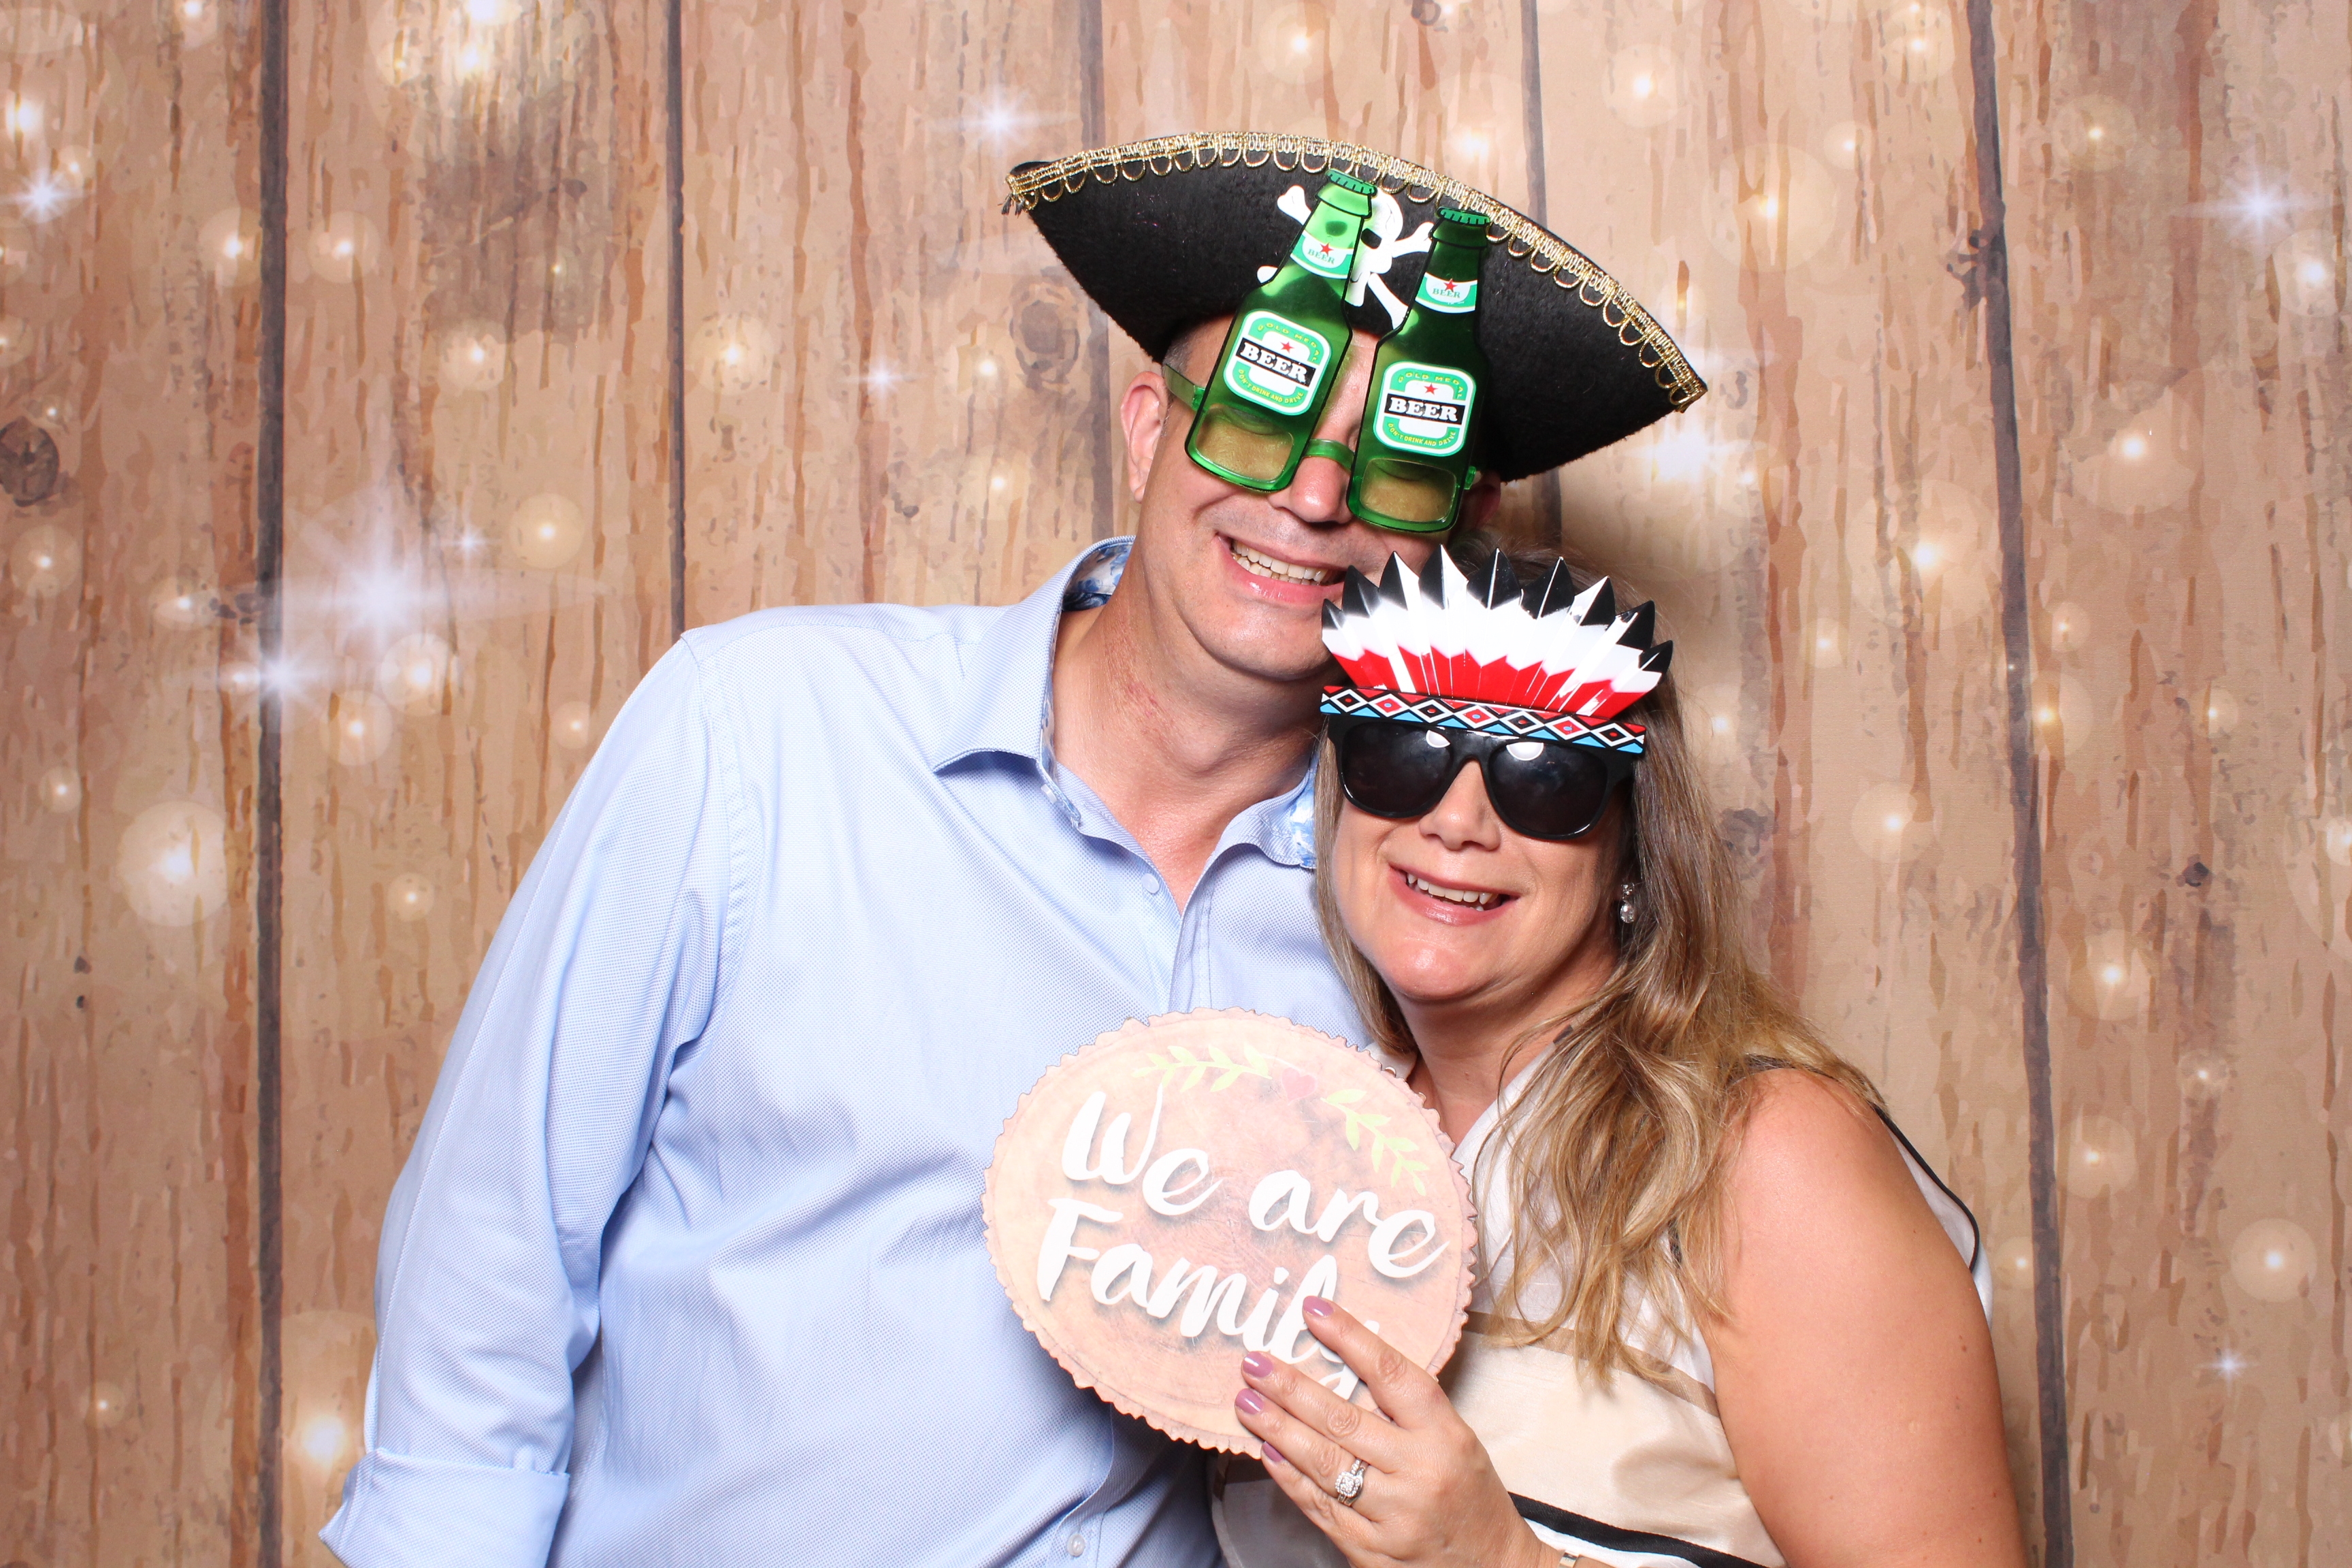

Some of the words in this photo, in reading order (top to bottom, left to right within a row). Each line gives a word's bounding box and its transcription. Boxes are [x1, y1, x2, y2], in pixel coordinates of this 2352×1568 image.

[1307, 248, 1335, 264] BEER
[1432, 288, 1460, 299] BEER
[1257, 322, 1290, 334] GOLD
[1294, 333, 1320, 362] MEDAL
[1239, 342, 1307, 383] BEER
[1238, 369, 1252, 389] DON'T
[1252, 385, 1271, 397] DRINK
[1271, 393, 1283, 404] AND
[1284, 391, 1304, 404] DRIVE
[1398, 372, 1429, 383] GOLD
[1435, 376, 1465, 399] MEDAL
[1388, 397, 1458, 422] BEER
[1388, 423, 1404, 440] DON'T
[1404, 436, 1424, 446] DRINK
[1438, 431, 1456, 446] DRIVE
[1062, 1082, 1223, 1216] We
[1248, 1169, 1450, 1278] are
